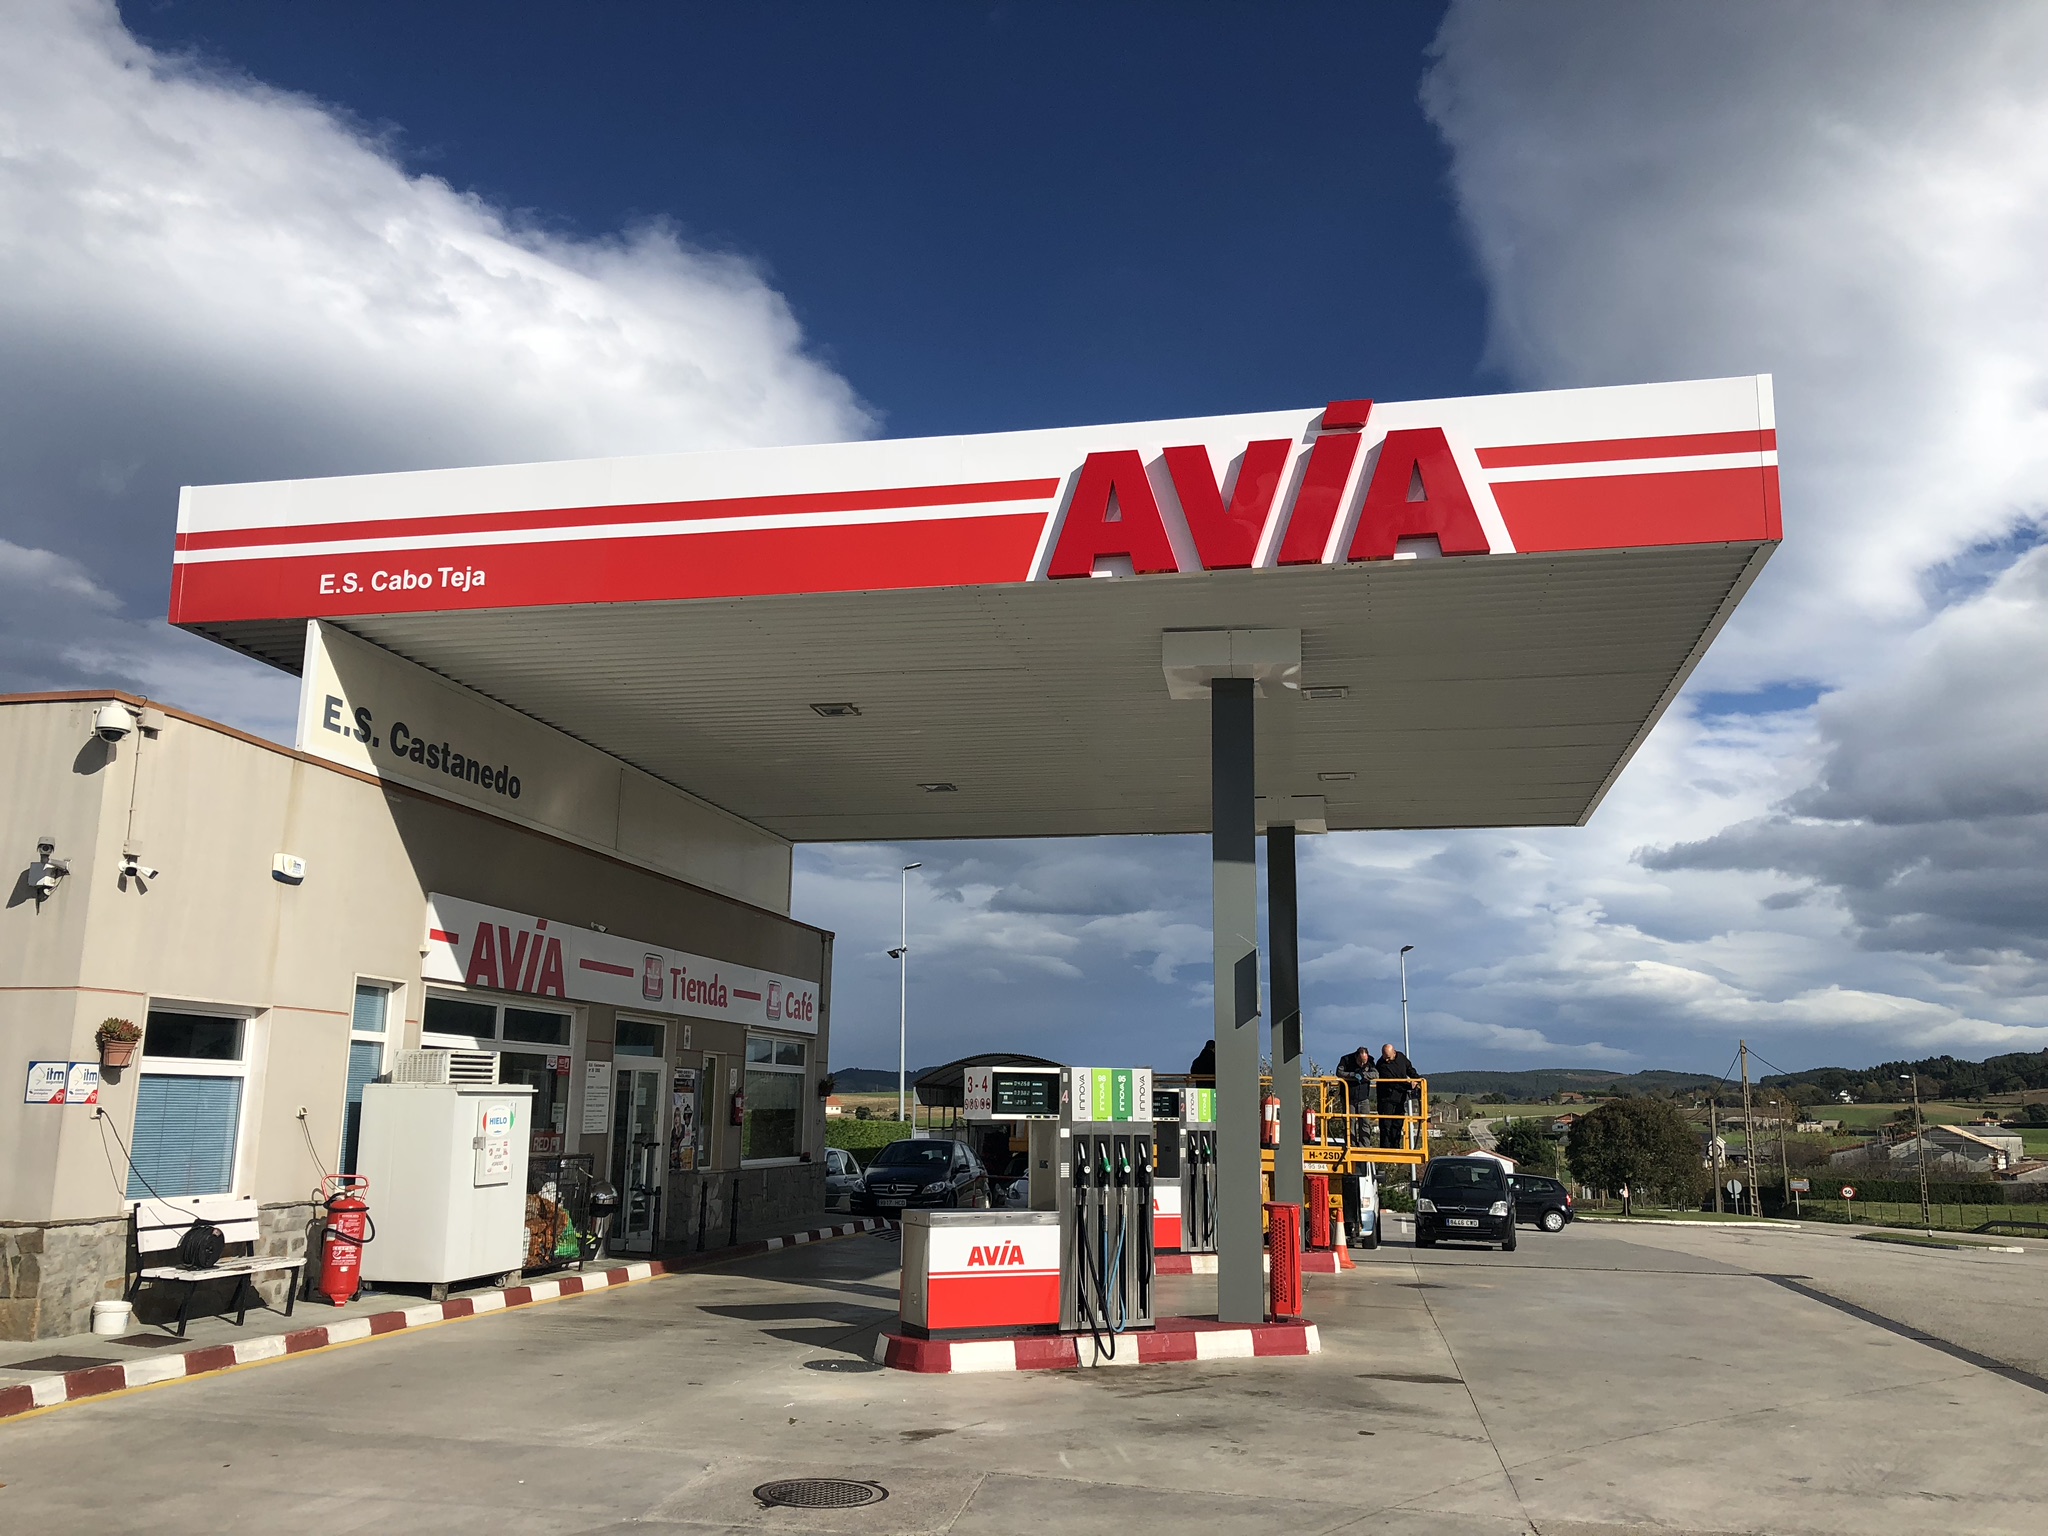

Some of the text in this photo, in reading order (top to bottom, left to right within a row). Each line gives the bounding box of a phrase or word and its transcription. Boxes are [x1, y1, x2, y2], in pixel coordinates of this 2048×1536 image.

[1046, 398, 1491, 579] AVIA
[319, 565, 486, 595] E.S. Cabo Teja
[322, 694, 521, 800] E.S. Castanedo
[464, 918, 566, 999] AVIA
[669, 965, 813, 1023] Tienda Café
[46, 1067, 65, 1080] itm
[83, 1068, 98, 1081] itm
[1117, 1074, 1127, 1083] 95
[1061, 1089, 1070, 1104] 4
[1180, 1102, 1186, 1113] 2
[489, 1116, 508, 1125] HIELO
[966, 1239, 1025, 1267] AVIA
